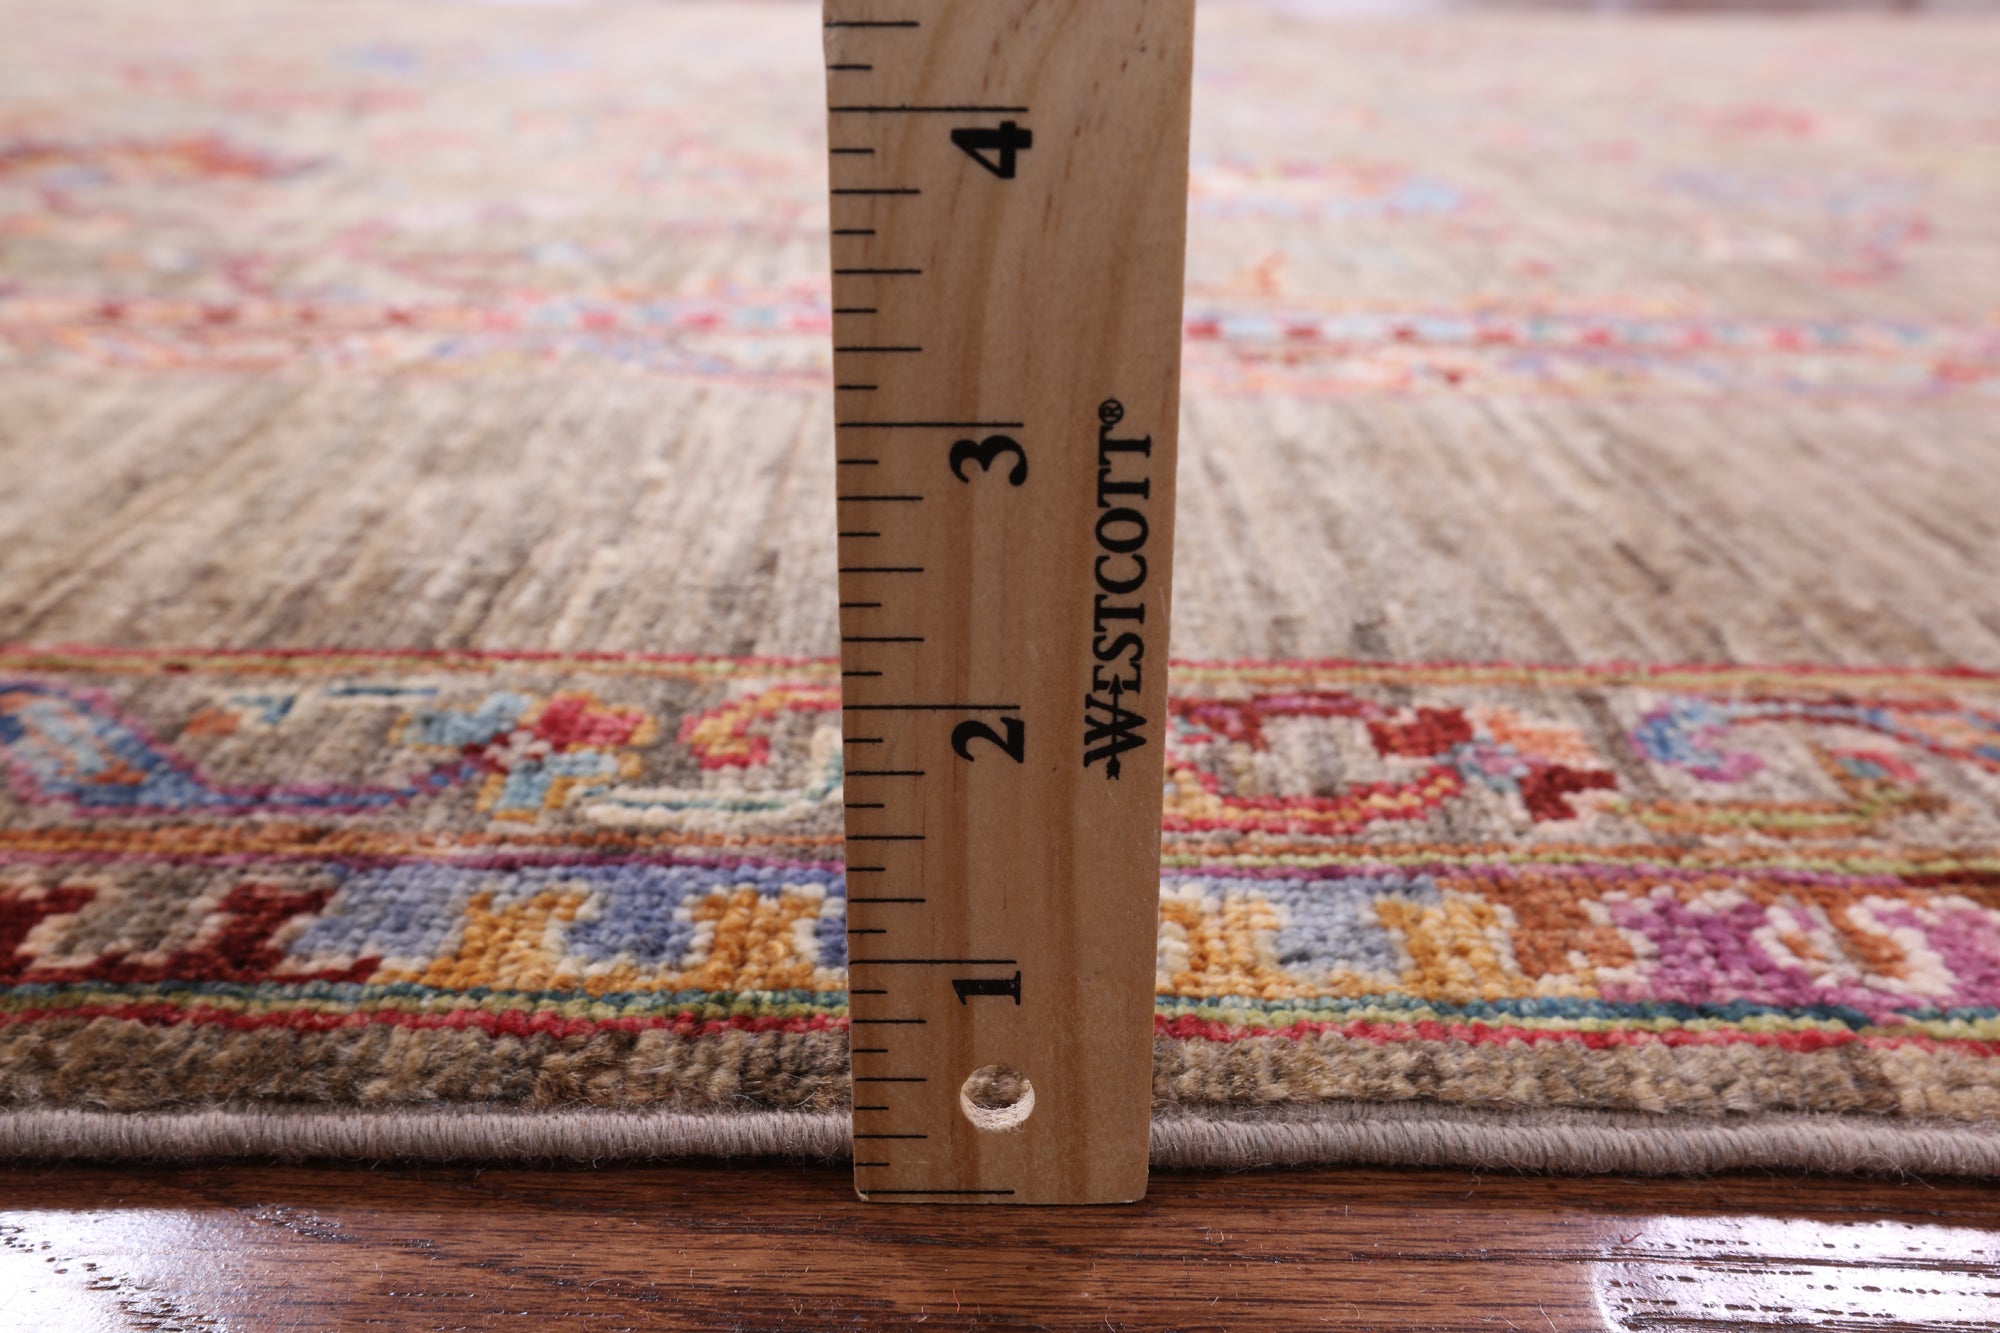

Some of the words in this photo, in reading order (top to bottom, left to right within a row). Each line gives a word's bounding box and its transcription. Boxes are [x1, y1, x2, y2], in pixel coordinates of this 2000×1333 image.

[950, 120, 1033, 180] 4
[948, 434, 1029, 487] 3
[950, 716, 1026, 765] 2
[951, 969, 1023, 1007] 1
